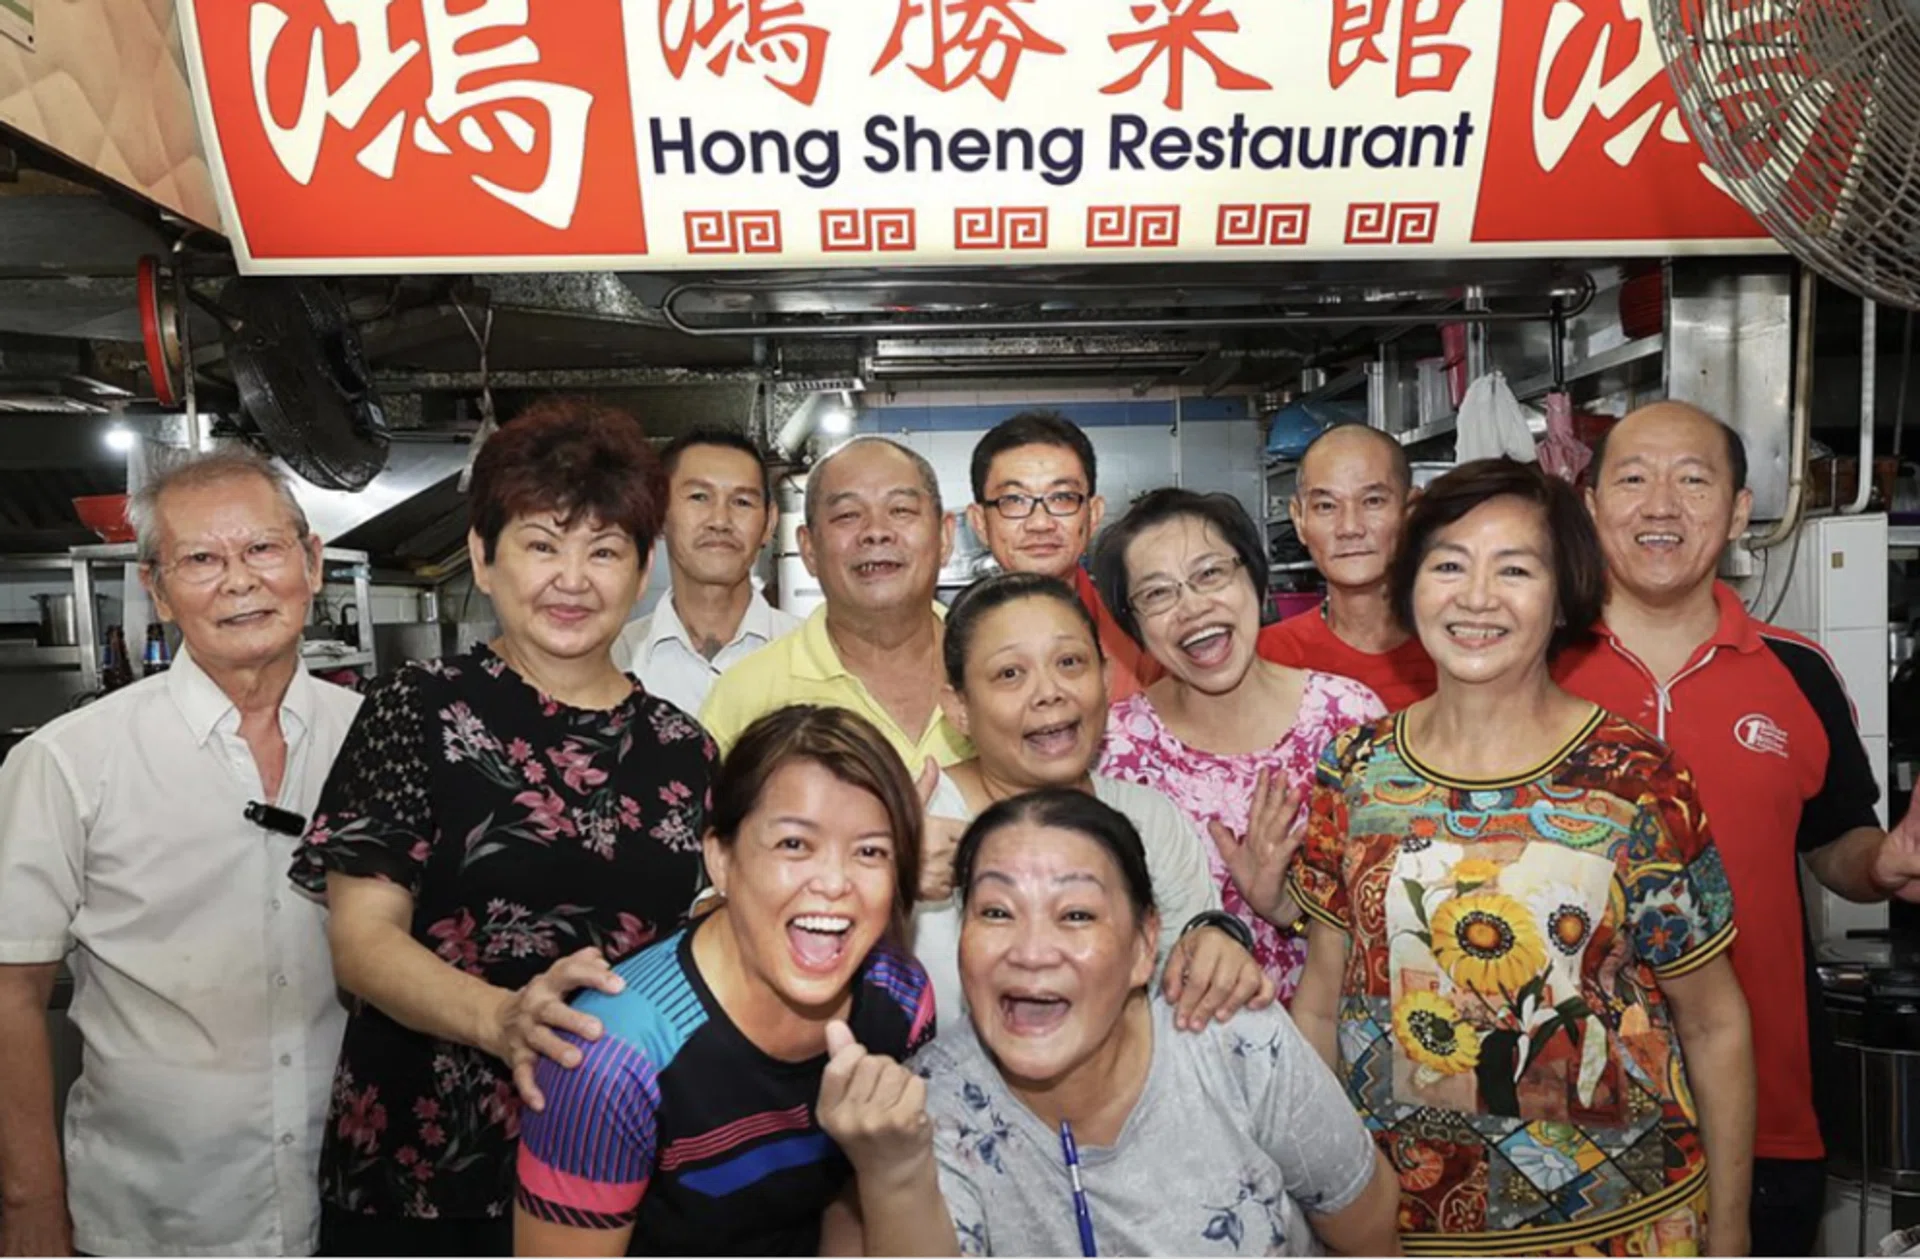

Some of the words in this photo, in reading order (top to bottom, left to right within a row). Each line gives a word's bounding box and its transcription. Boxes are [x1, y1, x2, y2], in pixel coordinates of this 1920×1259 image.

[650, 117, 840, 188] Hong
[864, 114, 1084, 186] Sheng
[1109, 111, 1474, 171] Restaurant
